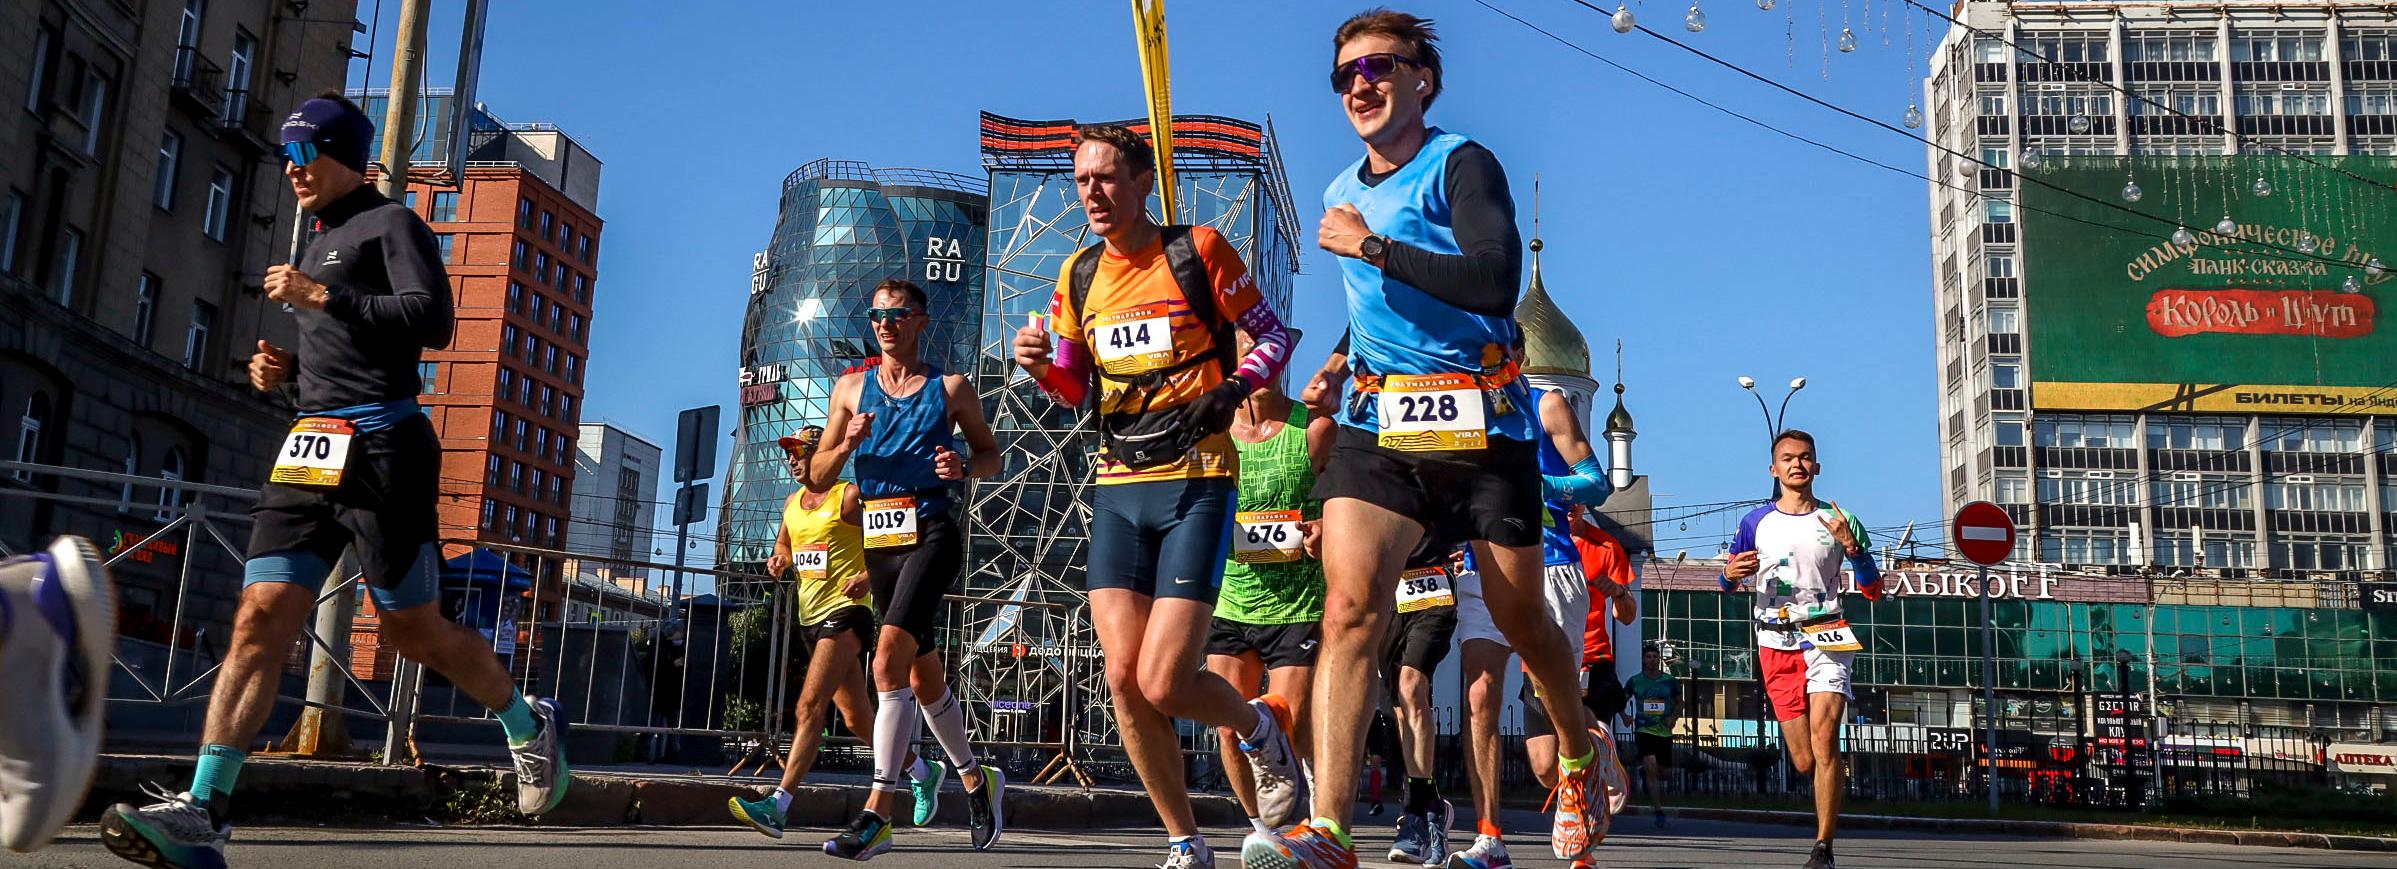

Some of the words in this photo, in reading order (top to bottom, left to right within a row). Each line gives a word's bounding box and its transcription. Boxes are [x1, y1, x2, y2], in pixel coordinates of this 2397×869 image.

[927, 237, 961, 258] RA
[753, 250, 768, 271] RA
[926, 262, 961, 282] GU
[751, 274, 767, 294] GU
[1111, 323, 1150, 348] 414
[1147, 352, 1169, 360] VIRA
[1399, 394, 1458, 422] 228
[2235, 392, 2343, 405] БИЛЕТЫ
[2350, 396, 2365, 406] на
[289, 434, 330, 460] 370
[868, 510, 906, 530] 1019
[1247, 523, 1287, 543] 676
[795, 552, 821, 567] 1046
[1405, 577, 1438, 595] 338
[2373, 589, 2397, 603] ST
[1817, 631, 1844, 643] 416
[1028, 648, 1061, 657] ДОДО
[1930, 732, 1969, 750] 2UP
[2334, 753, 2394, 767] АПТЕКА
